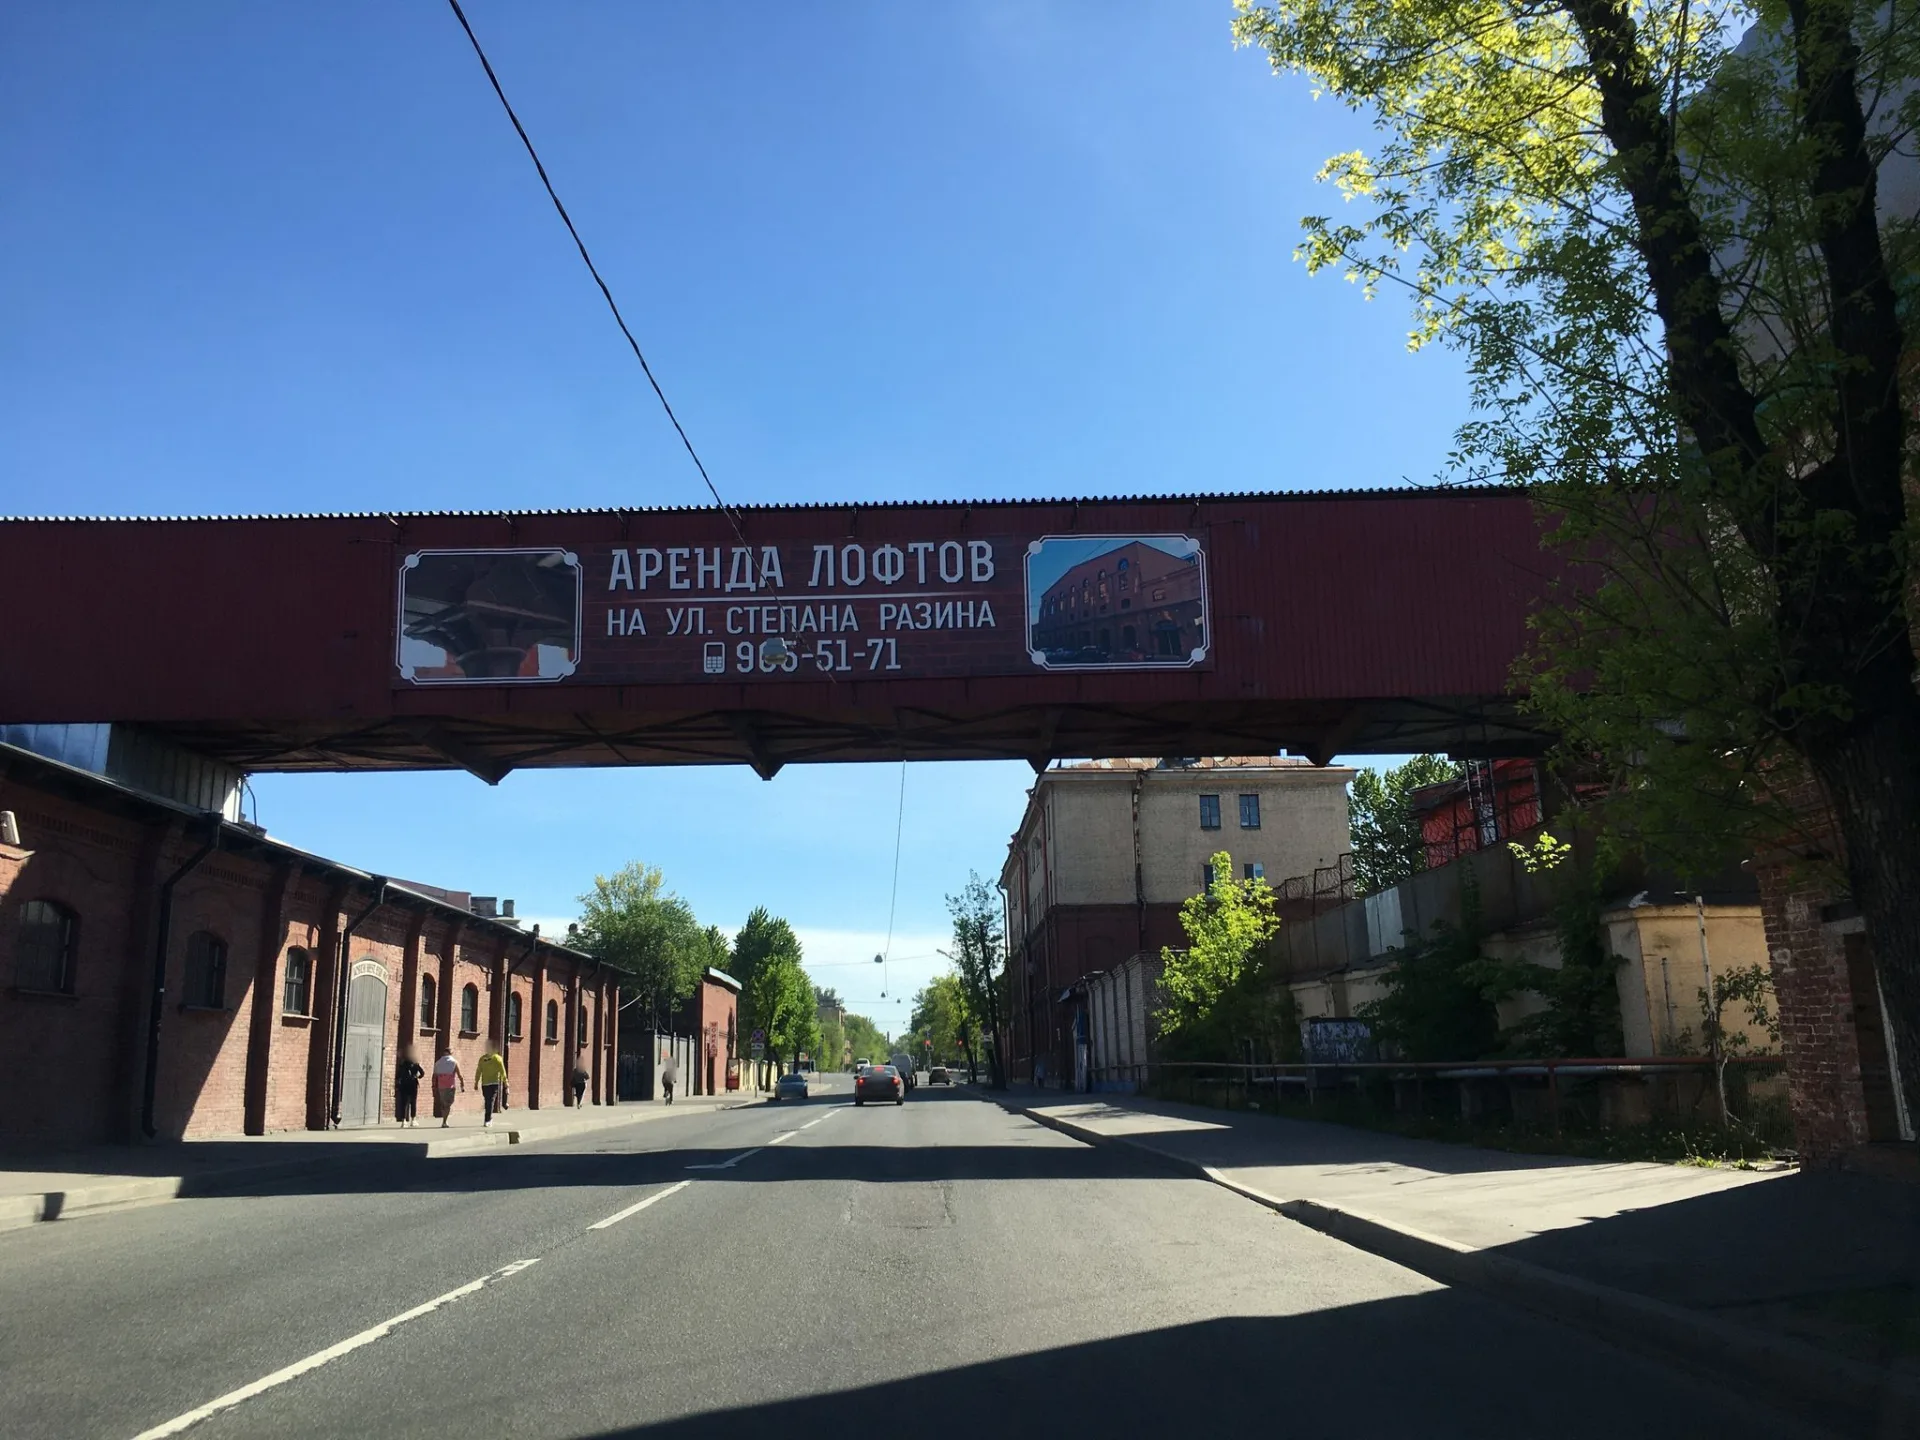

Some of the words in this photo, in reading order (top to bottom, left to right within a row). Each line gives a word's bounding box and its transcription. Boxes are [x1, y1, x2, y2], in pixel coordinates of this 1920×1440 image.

[608, 545, 785, 592] АРЕНДА
[808, 540, 996, 587] ЛОФТОВ
[607, 607, 647, 636] НА
[666, 606, 714, 636] УЛ.
[726, 603, 859, 635] СТЕПАНА
[880, 600, 997, 632] РАЗИНА
